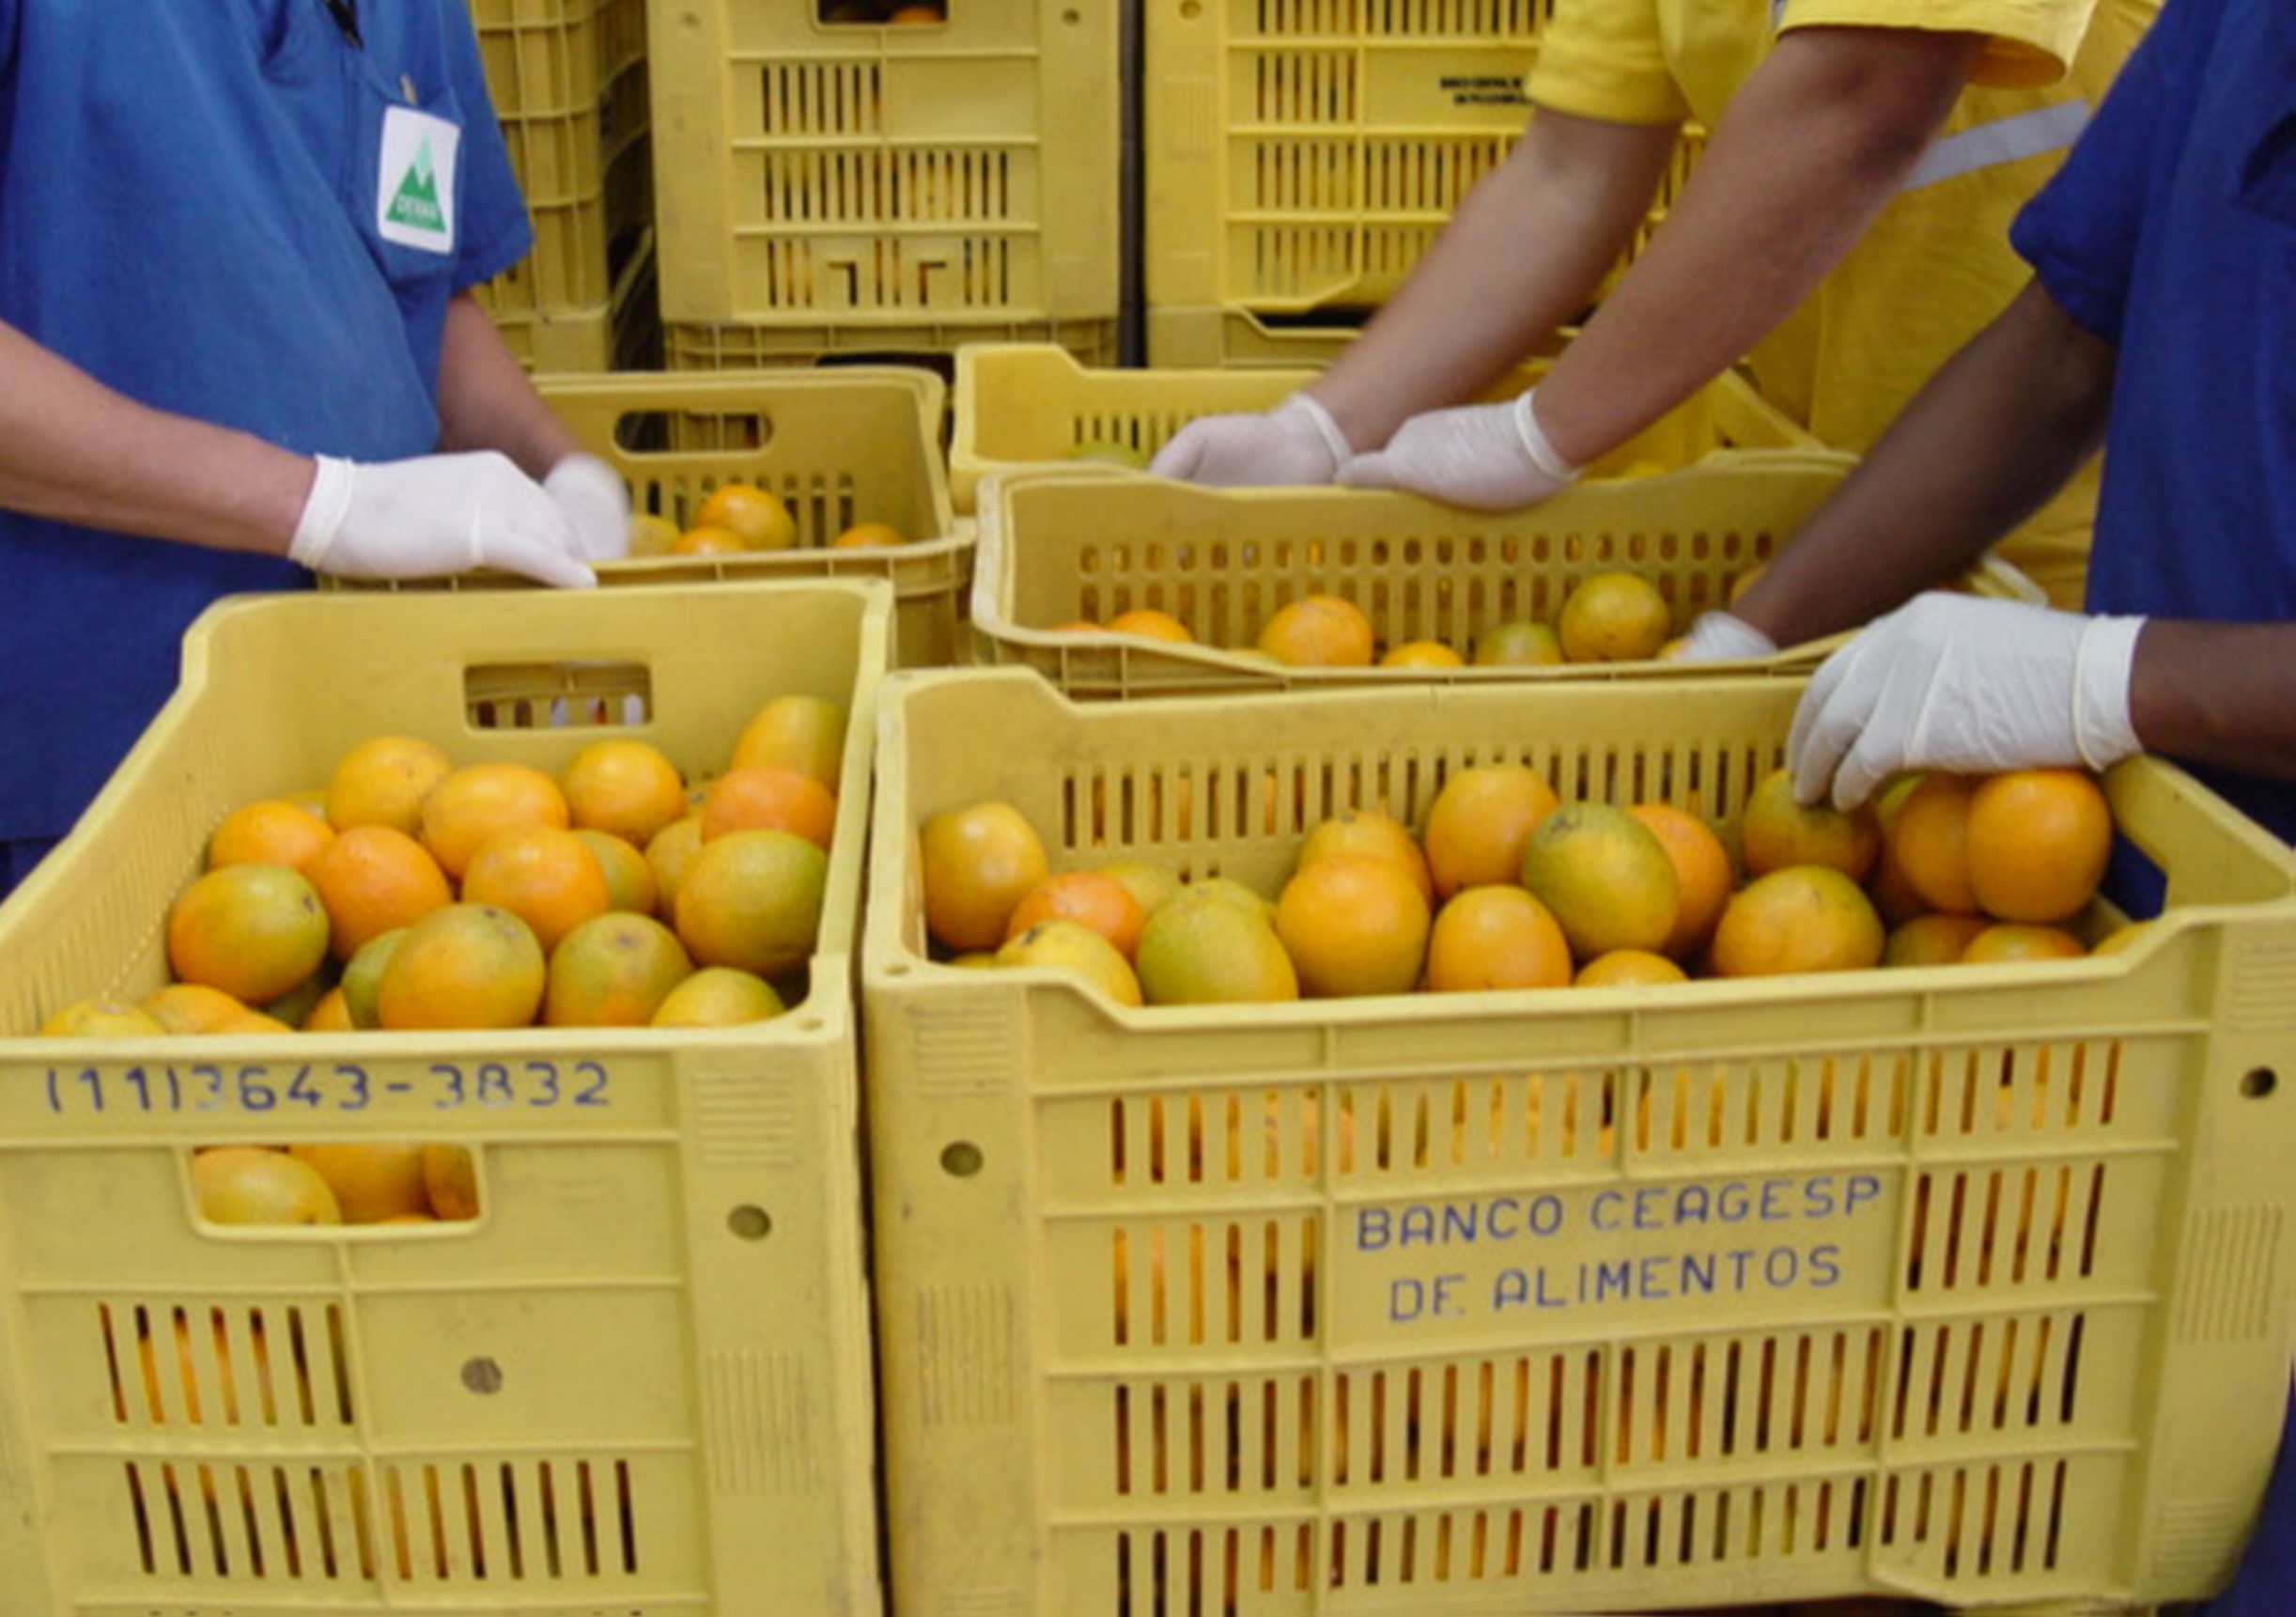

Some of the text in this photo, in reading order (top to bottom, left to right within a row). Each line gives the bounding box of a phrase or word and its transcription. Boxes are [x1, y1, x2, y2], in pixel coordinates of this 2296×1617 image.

[1356, 1174, 1882, 1251] BANCO CEAGESP
[1389, 1245, 1842, 1323] DE ALIMENTOS
